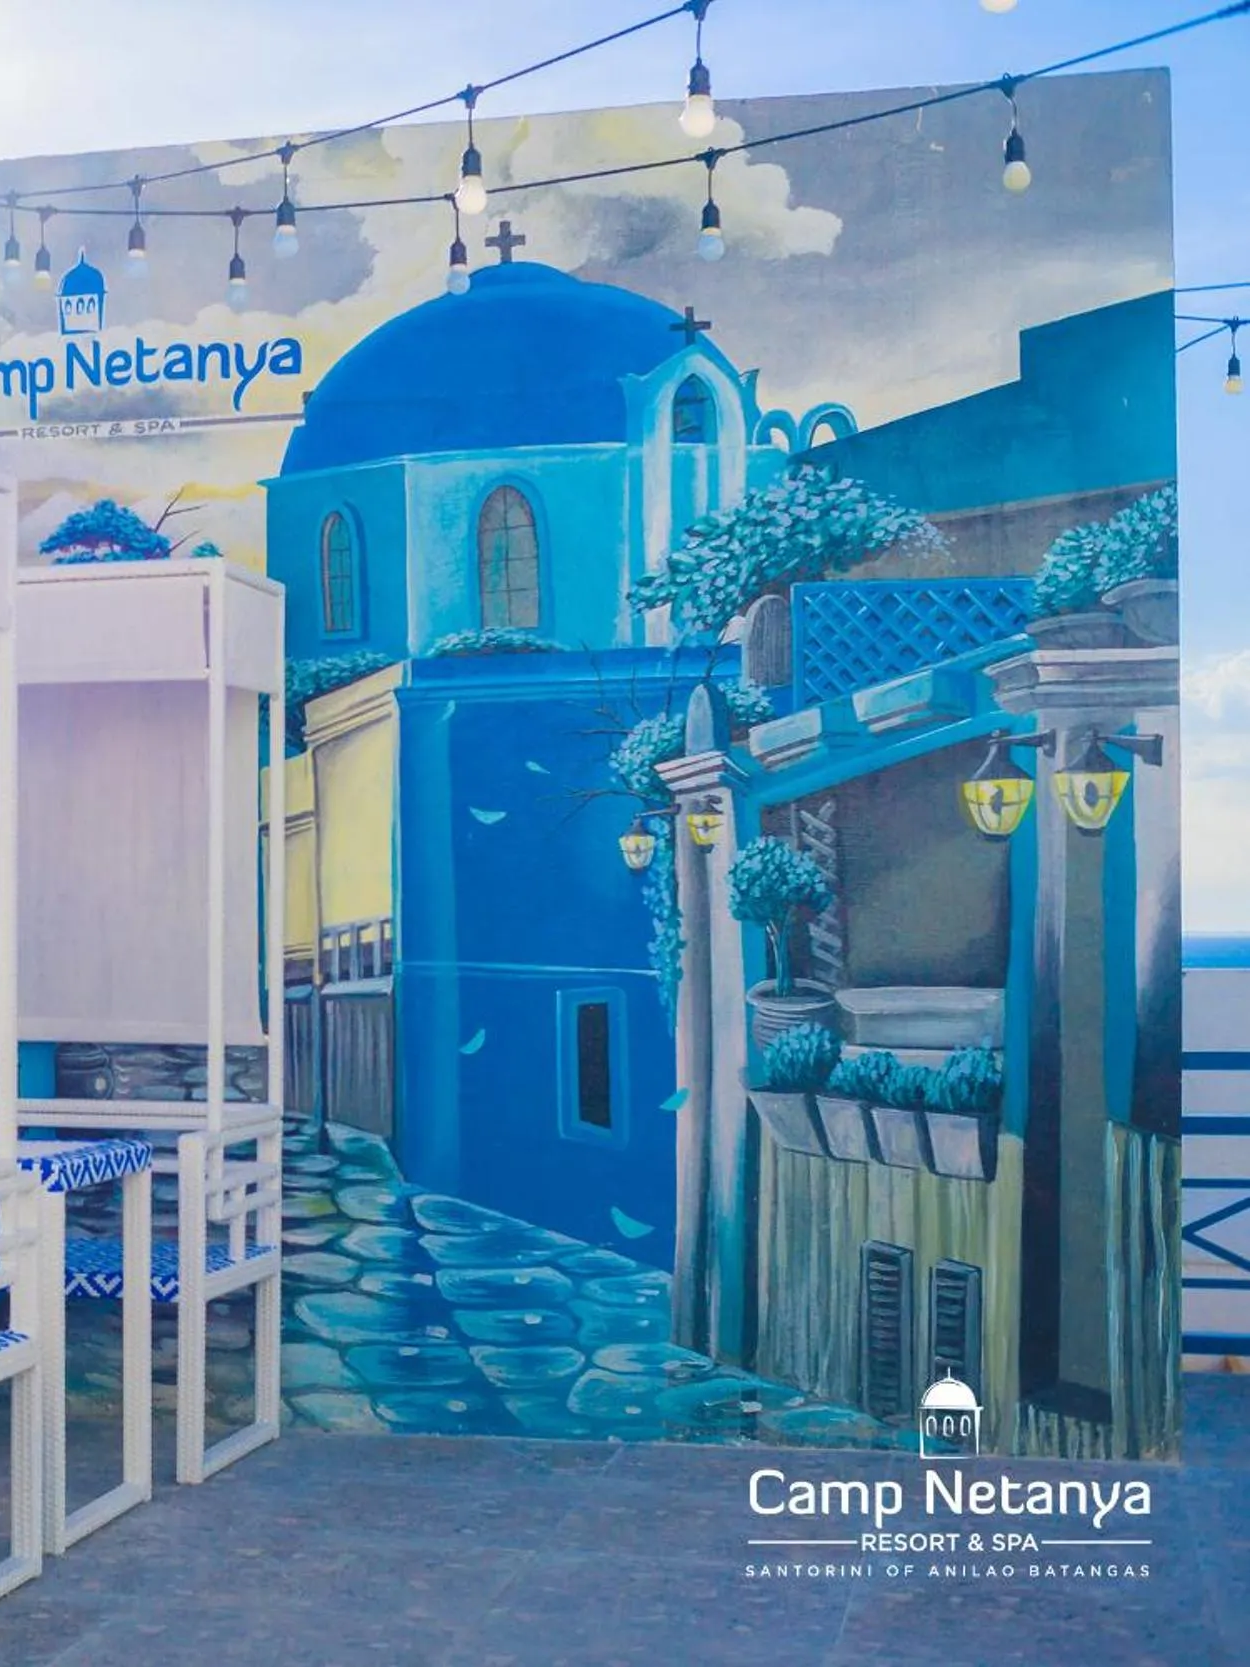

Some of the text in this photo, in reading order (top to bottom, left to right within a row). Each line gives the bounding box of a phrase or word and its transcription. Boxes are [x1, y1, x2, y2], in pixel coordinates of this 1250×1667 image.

[65, 336, 303, 412] Netanya
[21, 419, 176, 440] RESORT & SPA
